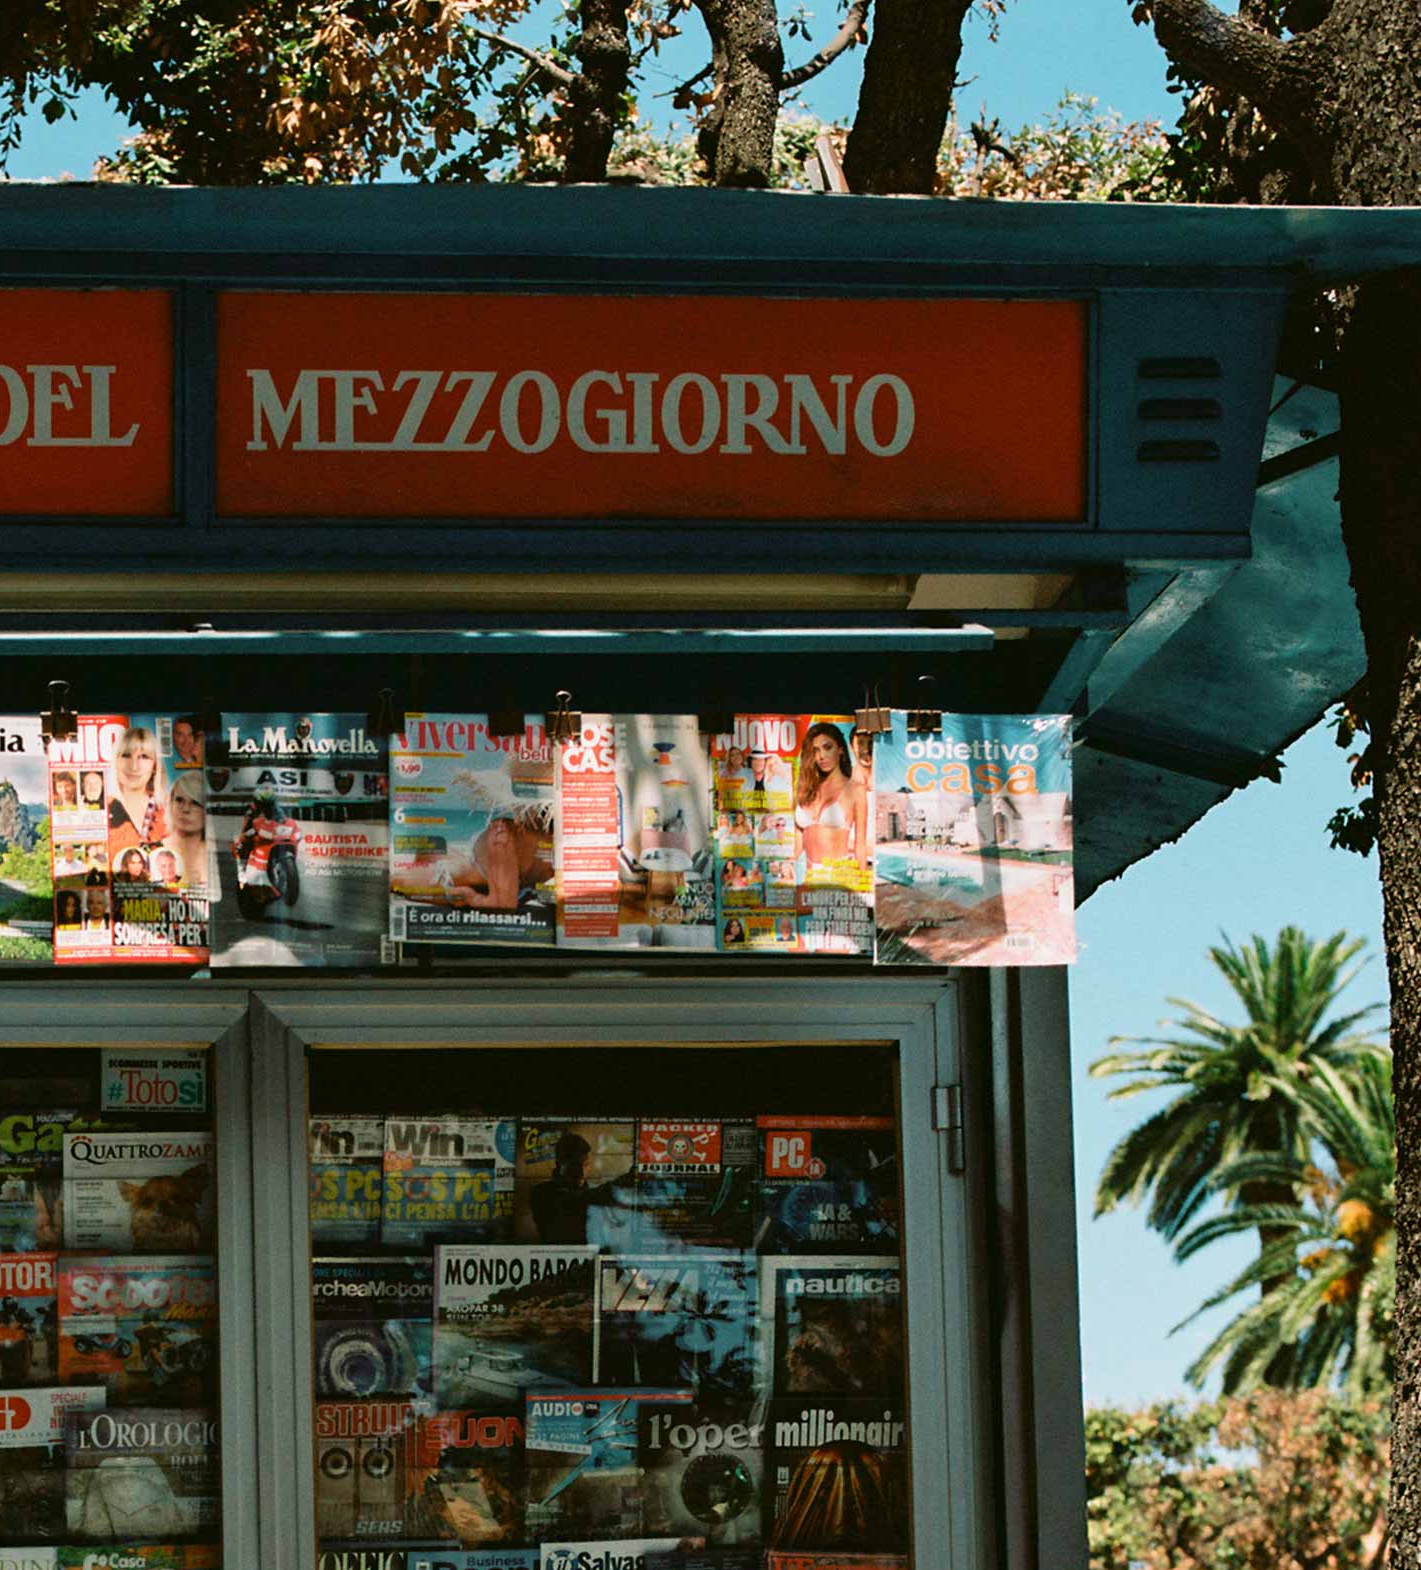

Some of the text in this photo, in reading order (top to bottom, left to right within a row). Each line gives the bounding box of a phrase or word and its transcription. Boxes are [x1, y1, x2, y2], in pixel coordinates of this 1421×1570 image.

[246, 368, 916, 457] MEZZOGIORNO
[228, 726, 380, 755] La Manovella
[569, 722, 628, 749] OSE
[905, 737, 1040, 762] obiettivo
[256, 770, 308, 787] ASI
[906, 761, 1040, 796] casa
[304, 833, 368, 845] BAUTISTA
[421, 912, 444, 924] ora
[446, 910, 461, 924] di
[390, 1123, 465, 1157] Win
[770, 1136, 806, 1170] PC
[444, 1258, 524, 1286] MONDO
[109, 1552, 147, 1569] Casa
[466, 1555, 526, 1568] Business
